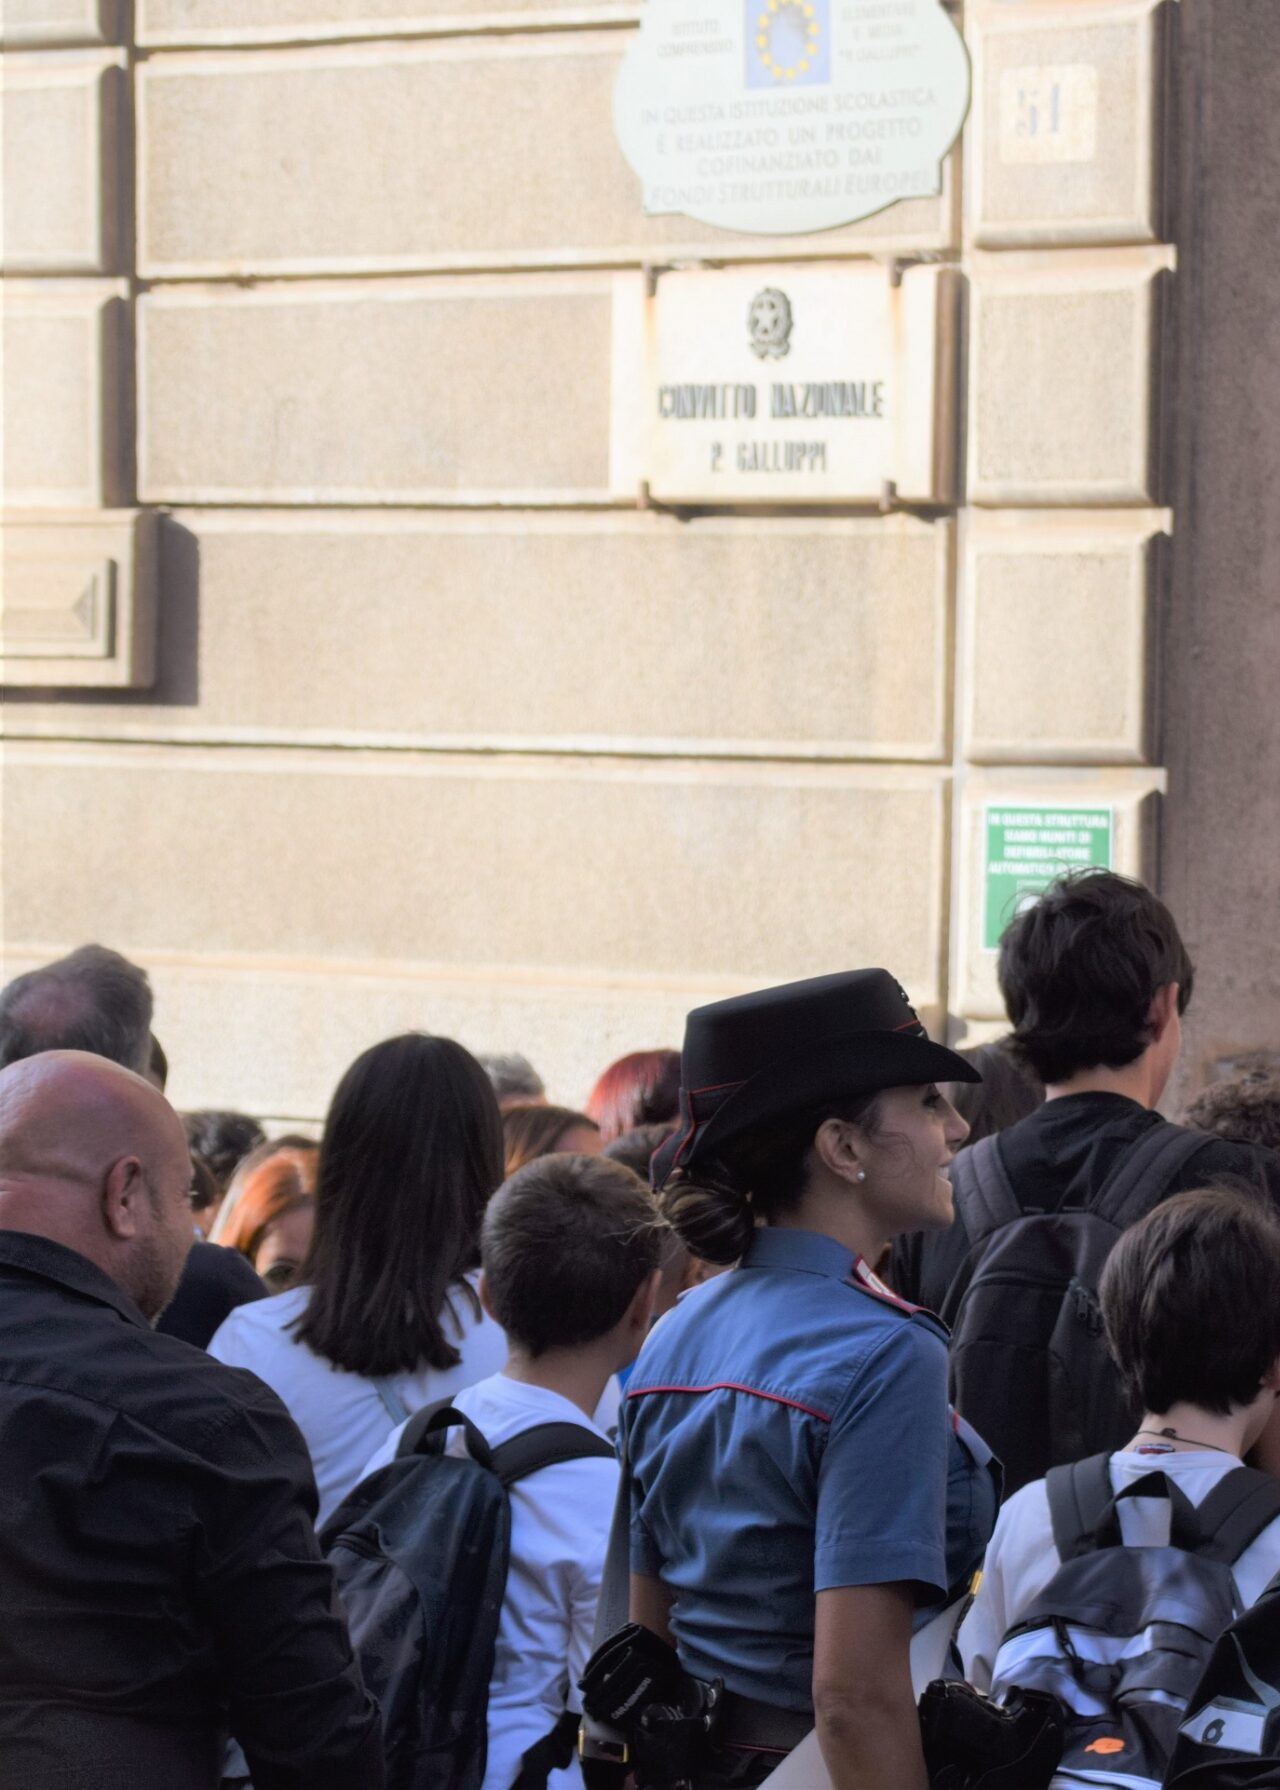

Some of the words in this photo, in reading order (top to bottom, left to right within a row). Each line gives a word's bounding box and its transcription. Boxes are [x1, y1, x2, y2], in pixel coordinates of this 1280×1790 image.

[671, 18, 720, 36] ISTITUTO
[656, 38, 734, 59] COMPRENSIVO
[640, 107, 659, 125] IN
[663, 103, 725, 125] QUESTA
[729, 95, 829, 120] ISTITUZIONE
[833, 86, 937, 112] SCOLASTICA
[1016, 83, 1062, 138] 51
[676, 127, 780, 153] REALIZZATO
[788, 126, 816, 146] UN
[826, 116, 923, 142] PROGETTO
[696, 148, 840, 177] COFINANZIATO
[848, 146, 883, 167] DAI
[652, 184, 715, 206] FONDI
[718, 175, 841, 205] STRUTTURALI
[844, 168, 930, 197] EUROPEI
[657, 382, 757, 420] CONVITTO
[771, 380, 884, 419] NAZIONALE
[737, 440, 828, 473] GALLUPPI
[1002, 812, 1041, 826] QUESTA
[1044, 814, 1107, 827] STRUTTURA
